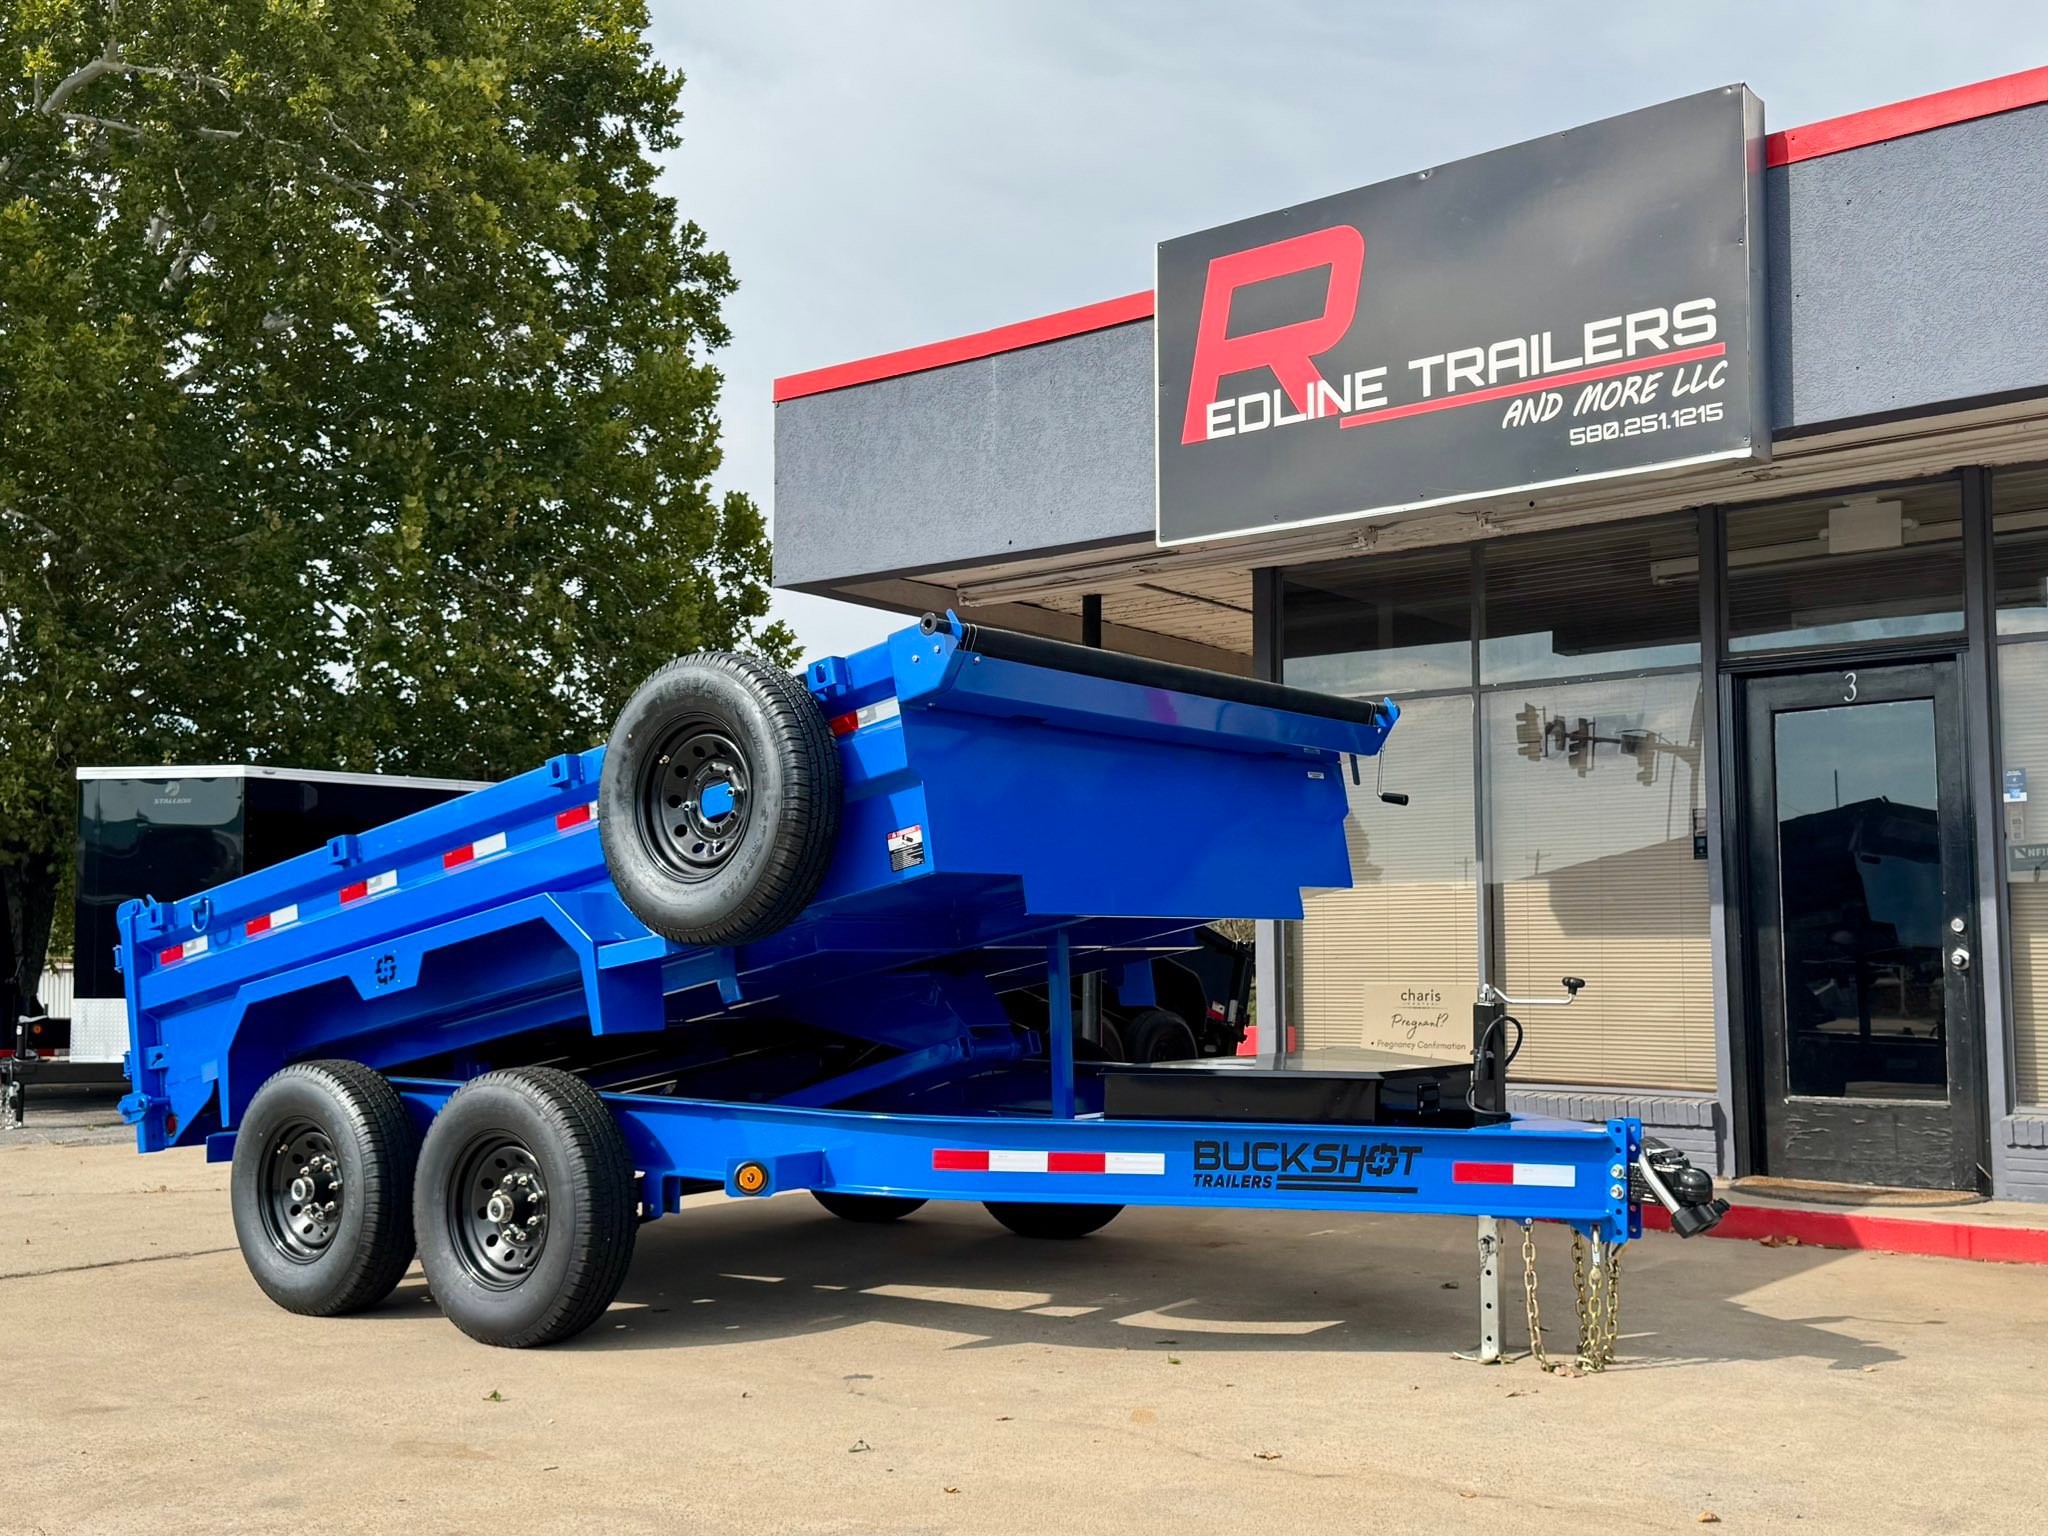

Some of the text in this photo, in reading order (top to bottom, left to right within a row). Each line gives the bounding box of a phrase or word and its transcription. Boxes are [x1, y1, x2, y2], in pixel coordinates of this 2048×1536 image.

[1408, 297, 1717, 397] TRAILERS
[1502, 360, 1728, 429] AND MORE LLC
[1569, 402, 1724, 446] 580.251.1215
[1843, 672, 1857, 702] 3
[2028, 847, 2048, 857] NFI
[1400, 988, 1441, 1002] charis
[1391, 1013, 1449, 1039] Pregnant?
[1376, 1039, 1466, 1050] Pregnancy Confirmation
[1193, 1140, 1423, 1181] BUCKSHOT
[1193, 1173, 1273, 1189] TRAILERS
